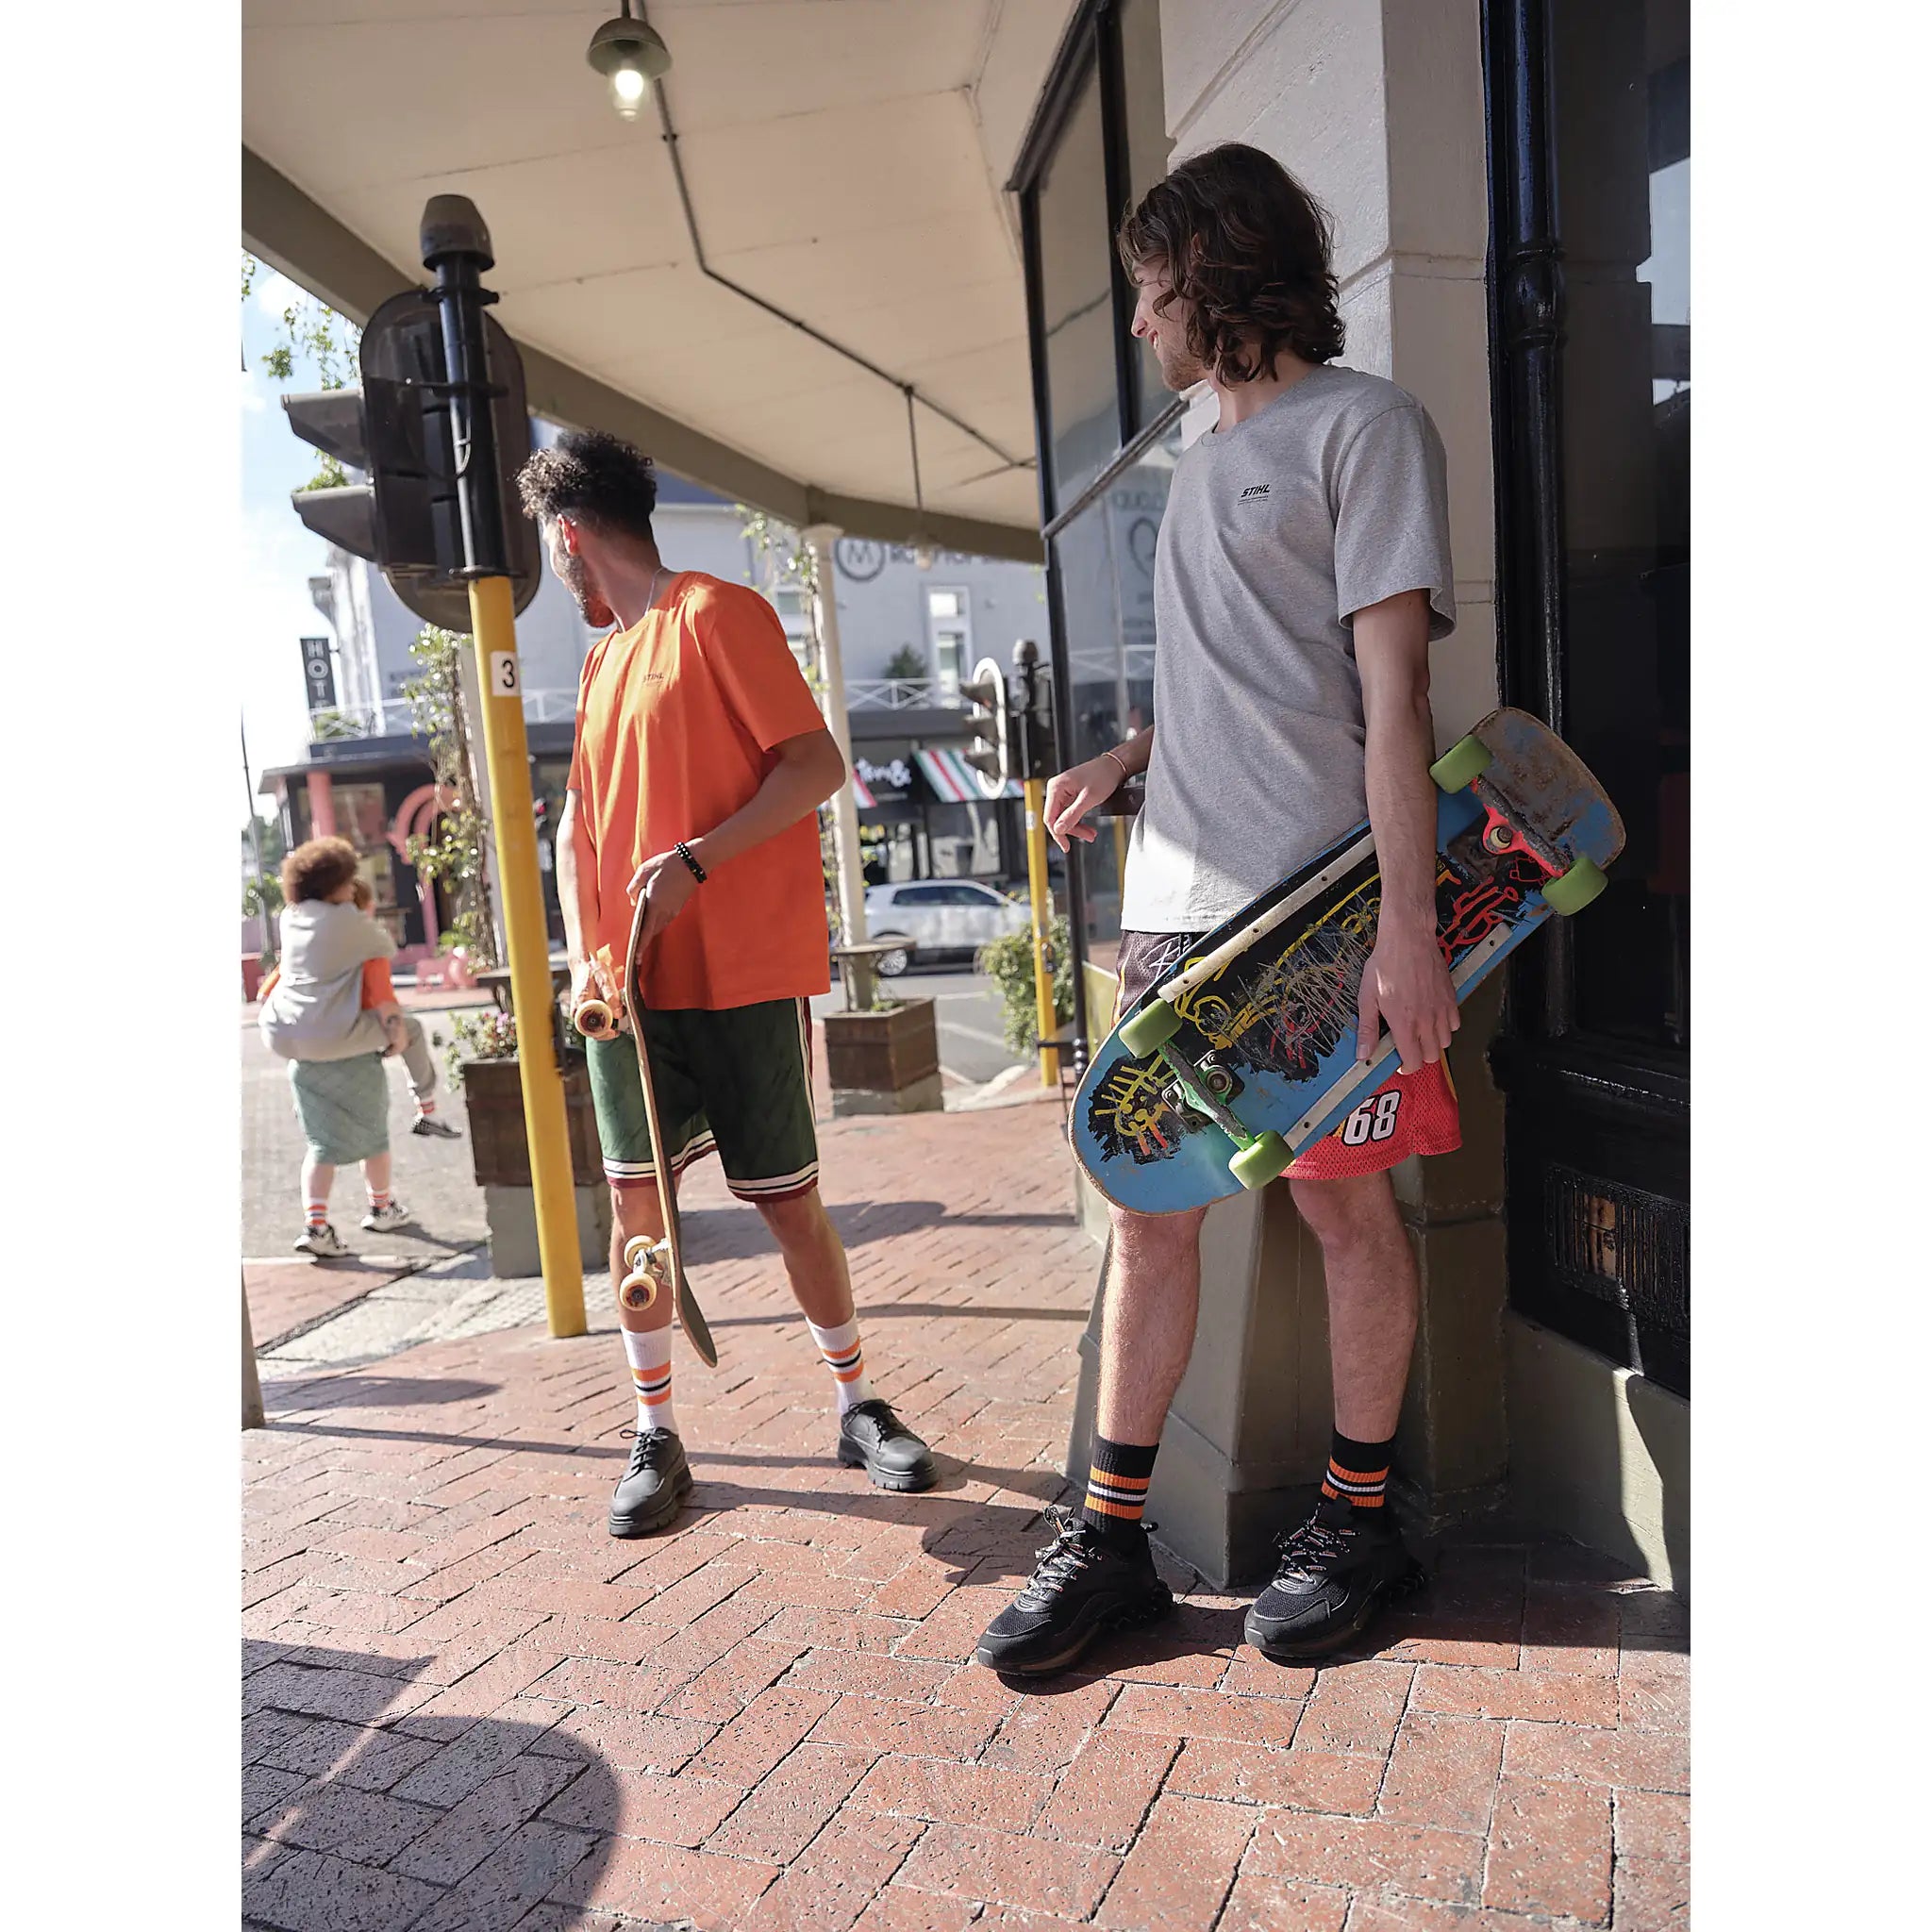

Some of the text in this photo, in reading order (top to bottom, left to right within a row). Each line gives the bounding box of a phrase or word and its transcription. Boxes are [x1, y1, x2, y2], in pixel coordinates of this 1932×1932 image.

[1241, 484, 1271, 498] STIHL
[502, 659, 515, 688] 3
[1341, 1089, 1402, 1147] 68
